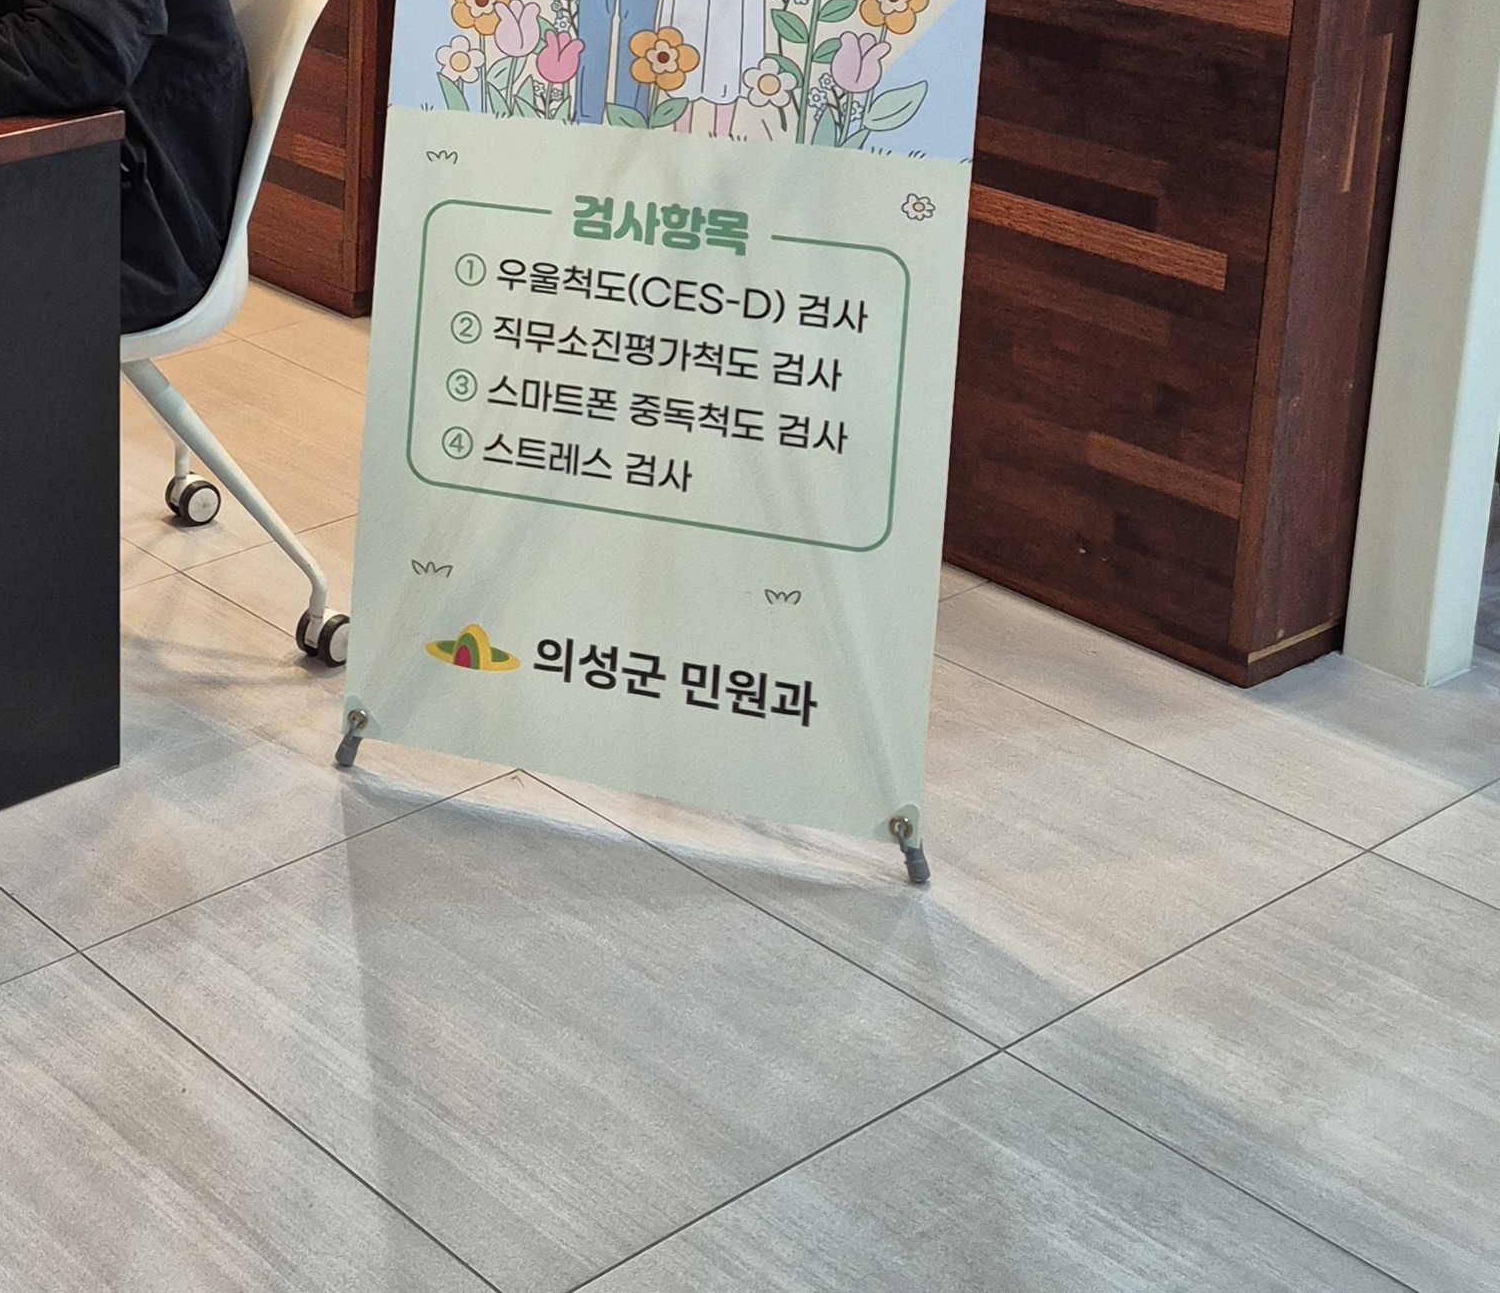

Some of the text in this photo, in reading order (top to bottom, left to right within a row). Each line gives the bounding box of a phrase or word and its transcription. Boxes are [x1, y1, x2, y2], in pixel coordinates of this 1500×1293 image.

[572, 194, 750, 256] 검사항목
[496, 257, 786, 325] 우울척도(CES-D)
[798, 293, 869, 334] 검사
[492, 314, 759, 381] 직무소진평가척도
[772, 351, 843, 393] 검사
[486, 374, 618, 422] 스마트폰
[629, 392, 765, 443] 중독척도
[778, 413, 849, 455] 검사
[482, 432, 613, 480] 스트레스
[625, 452, 693, 493] 검사
[533, 637, 818, 727] 의성군 민원과
